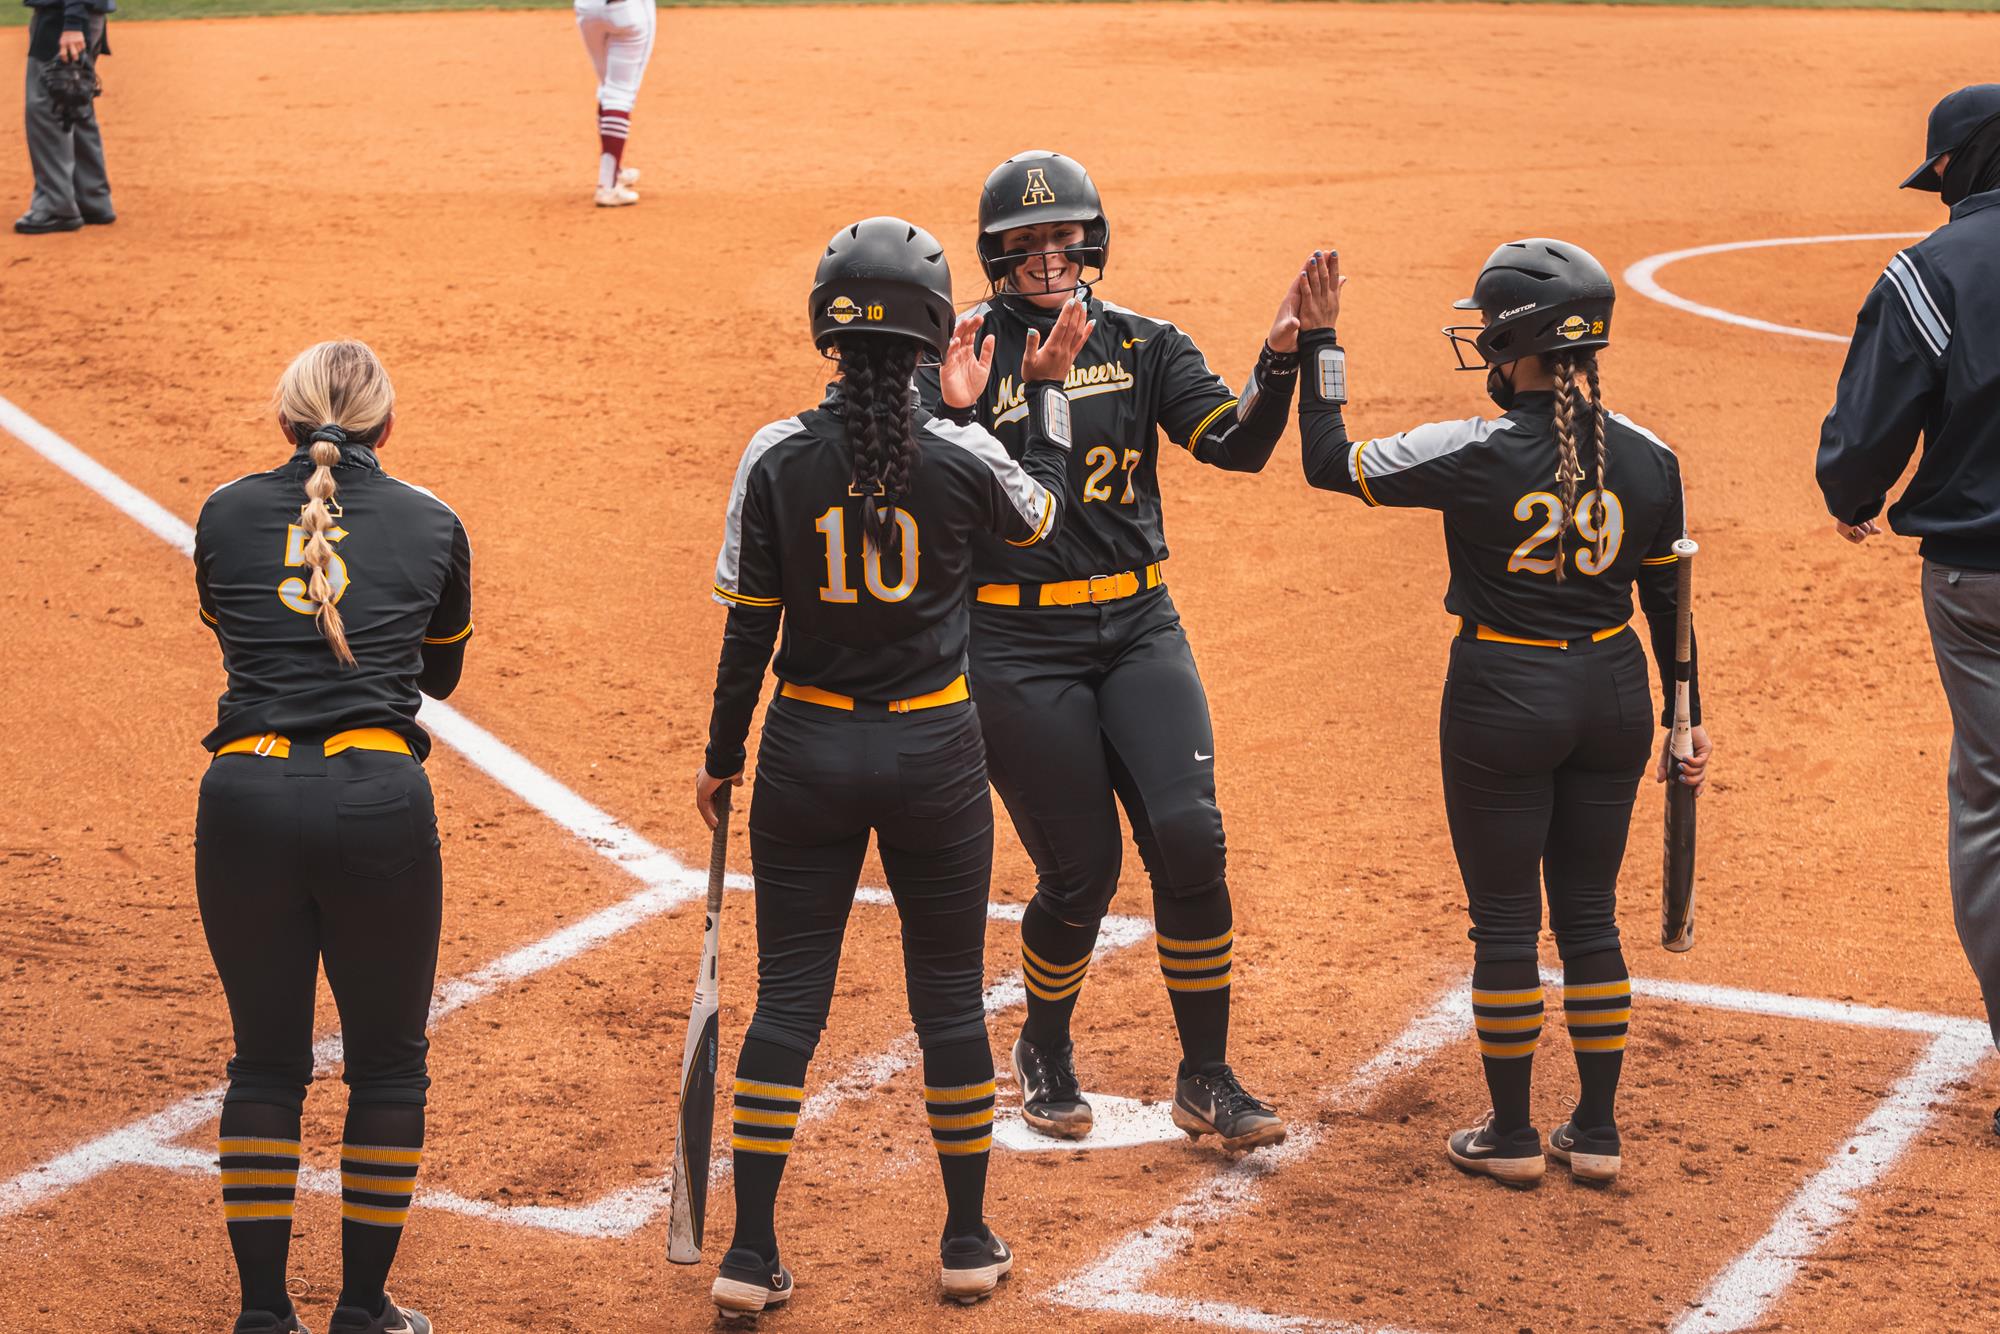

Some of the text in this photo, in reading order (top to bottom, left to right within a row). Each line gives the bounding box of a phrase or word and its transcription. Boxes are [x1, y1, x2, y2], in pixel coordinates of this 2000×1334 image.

[1022, 168, 1055, 206] A
[867, 304, 883, 320] 10
[1505, 302, 1537, 317] EASTON
[1592, 321, 1604, 335] 29
[1084, 446, 1143, 504] 27
[815, 506, 921, 603] 10
[1507, 488, 1624, 576] 29
[278, 523, 351, 615] 5
